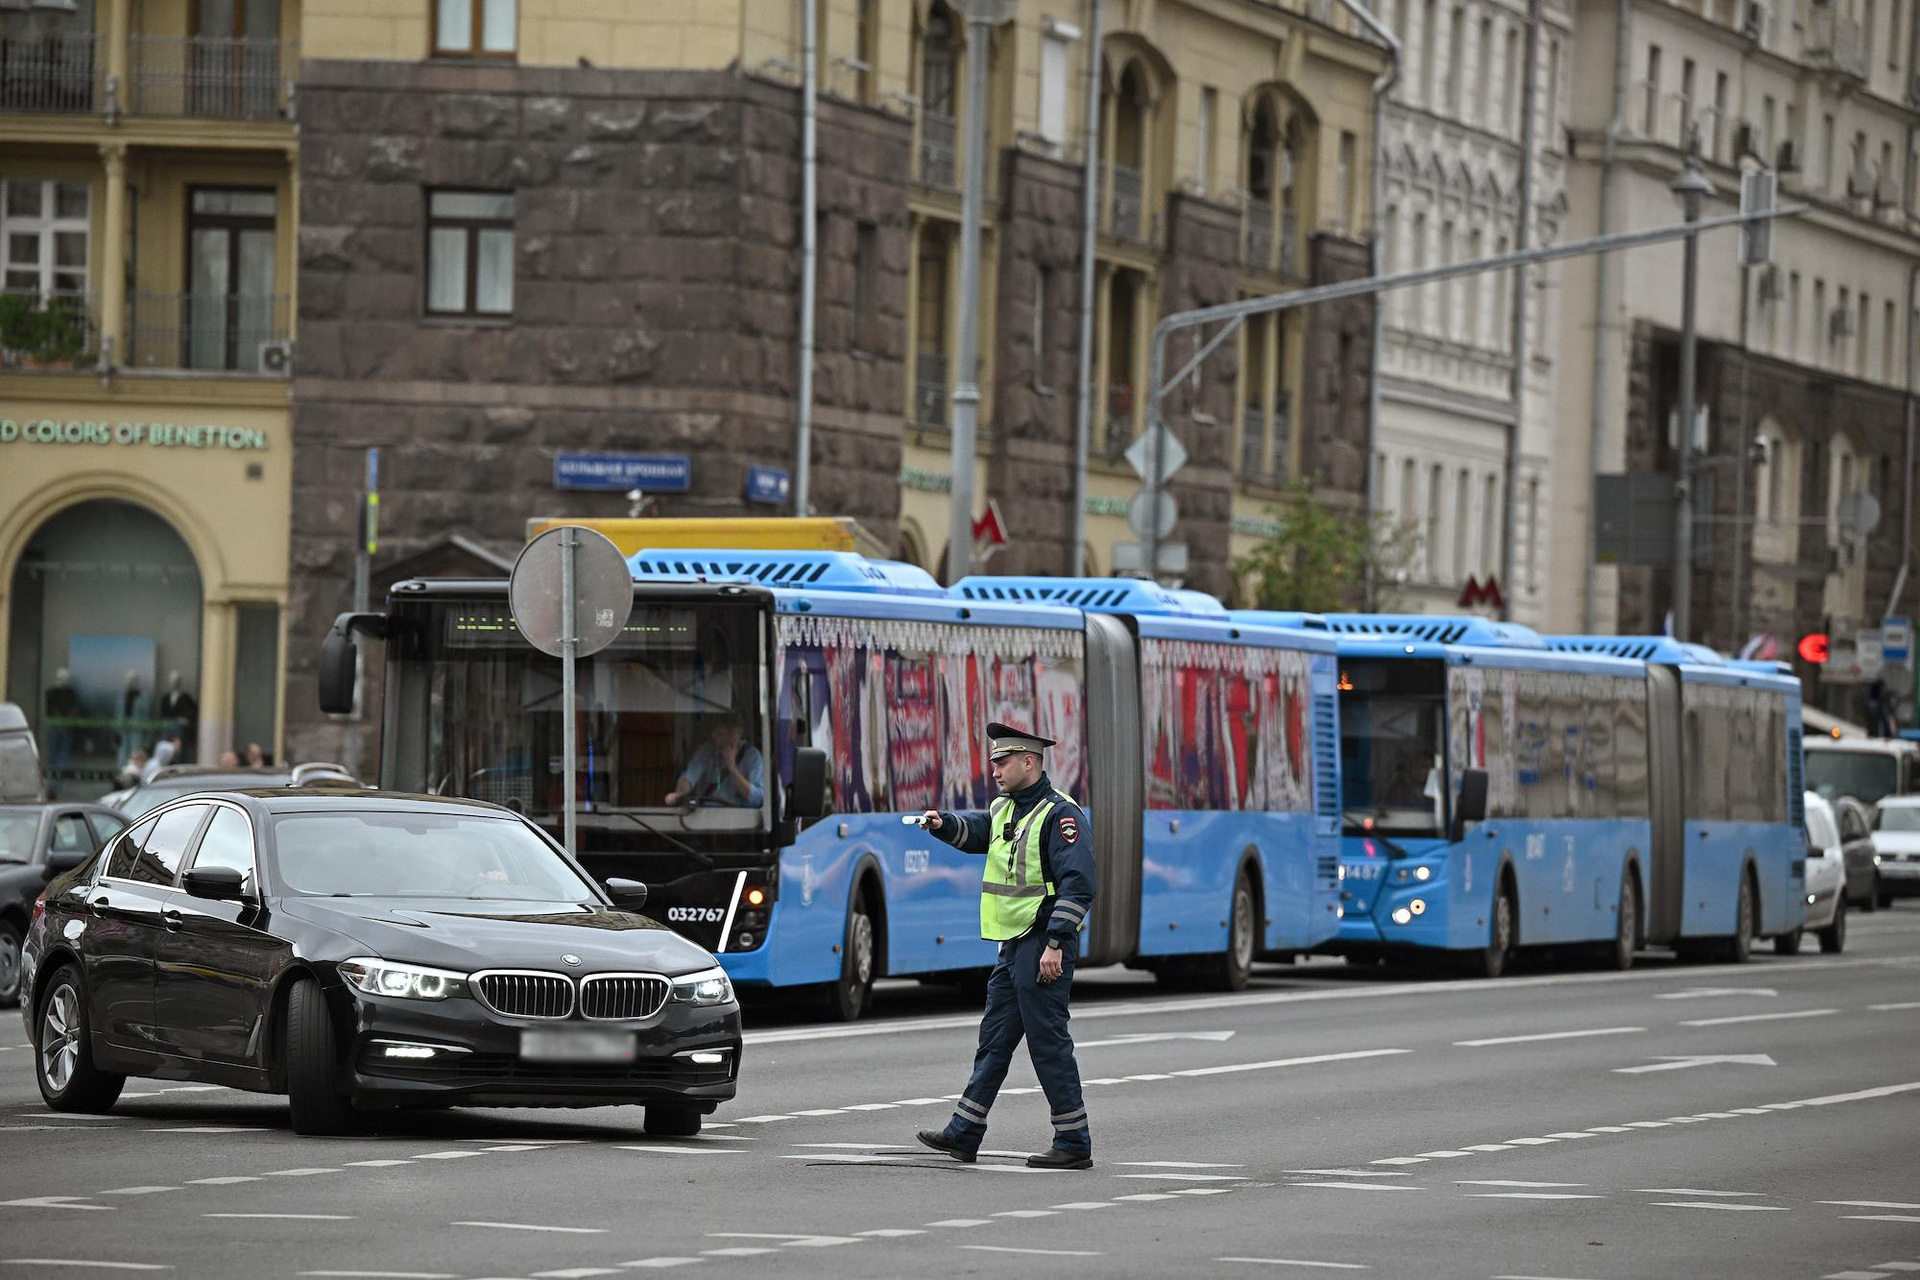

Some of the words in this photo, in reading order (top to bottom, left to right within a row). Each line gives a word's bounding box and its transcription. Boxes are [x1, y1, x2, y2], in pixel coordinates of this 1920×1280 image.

[0, 419, 19, 443] D
[23, 420, 110, 445] COLORS
[115, 421, 147, 445] OF
[667, 906, 726, 923] 032767
